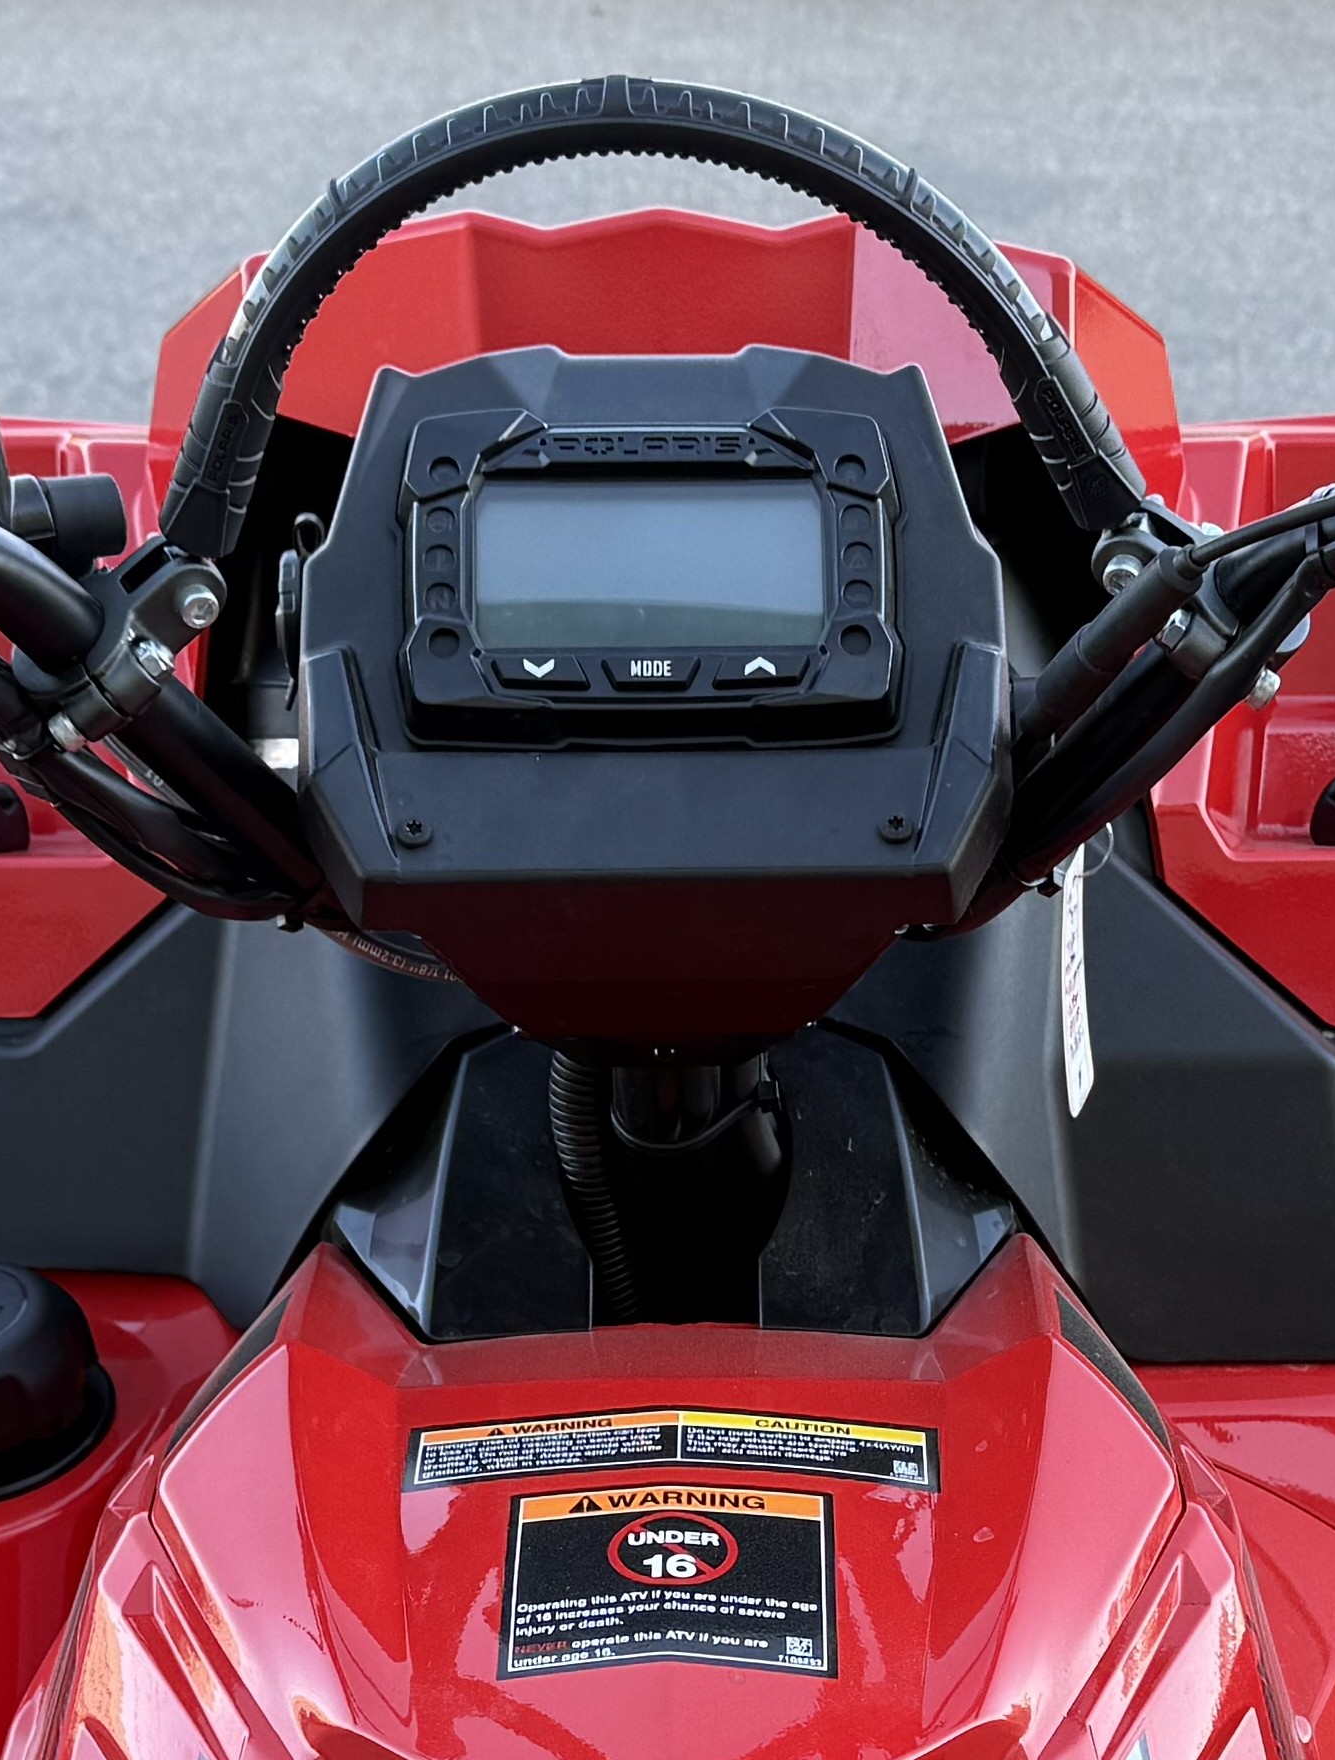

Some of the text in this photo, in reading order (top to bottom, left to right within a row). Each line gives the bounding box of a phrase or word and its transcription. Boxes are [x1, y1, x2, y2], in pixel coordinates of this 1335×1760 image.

[553, 437, 741, 455] POLARIS
[631, 660, 671, 676] MODE
[513, 1418, 612, 1433] WARNING
[755, 1419, 850, 1435] CAUTION
[608, 1491, 765, 1510] WARNING
[628, 1530, 720, 1546] UNDER
[643, 1554, 697, 1578] 16
[516, 1617, 624, 1637] injury or death.
